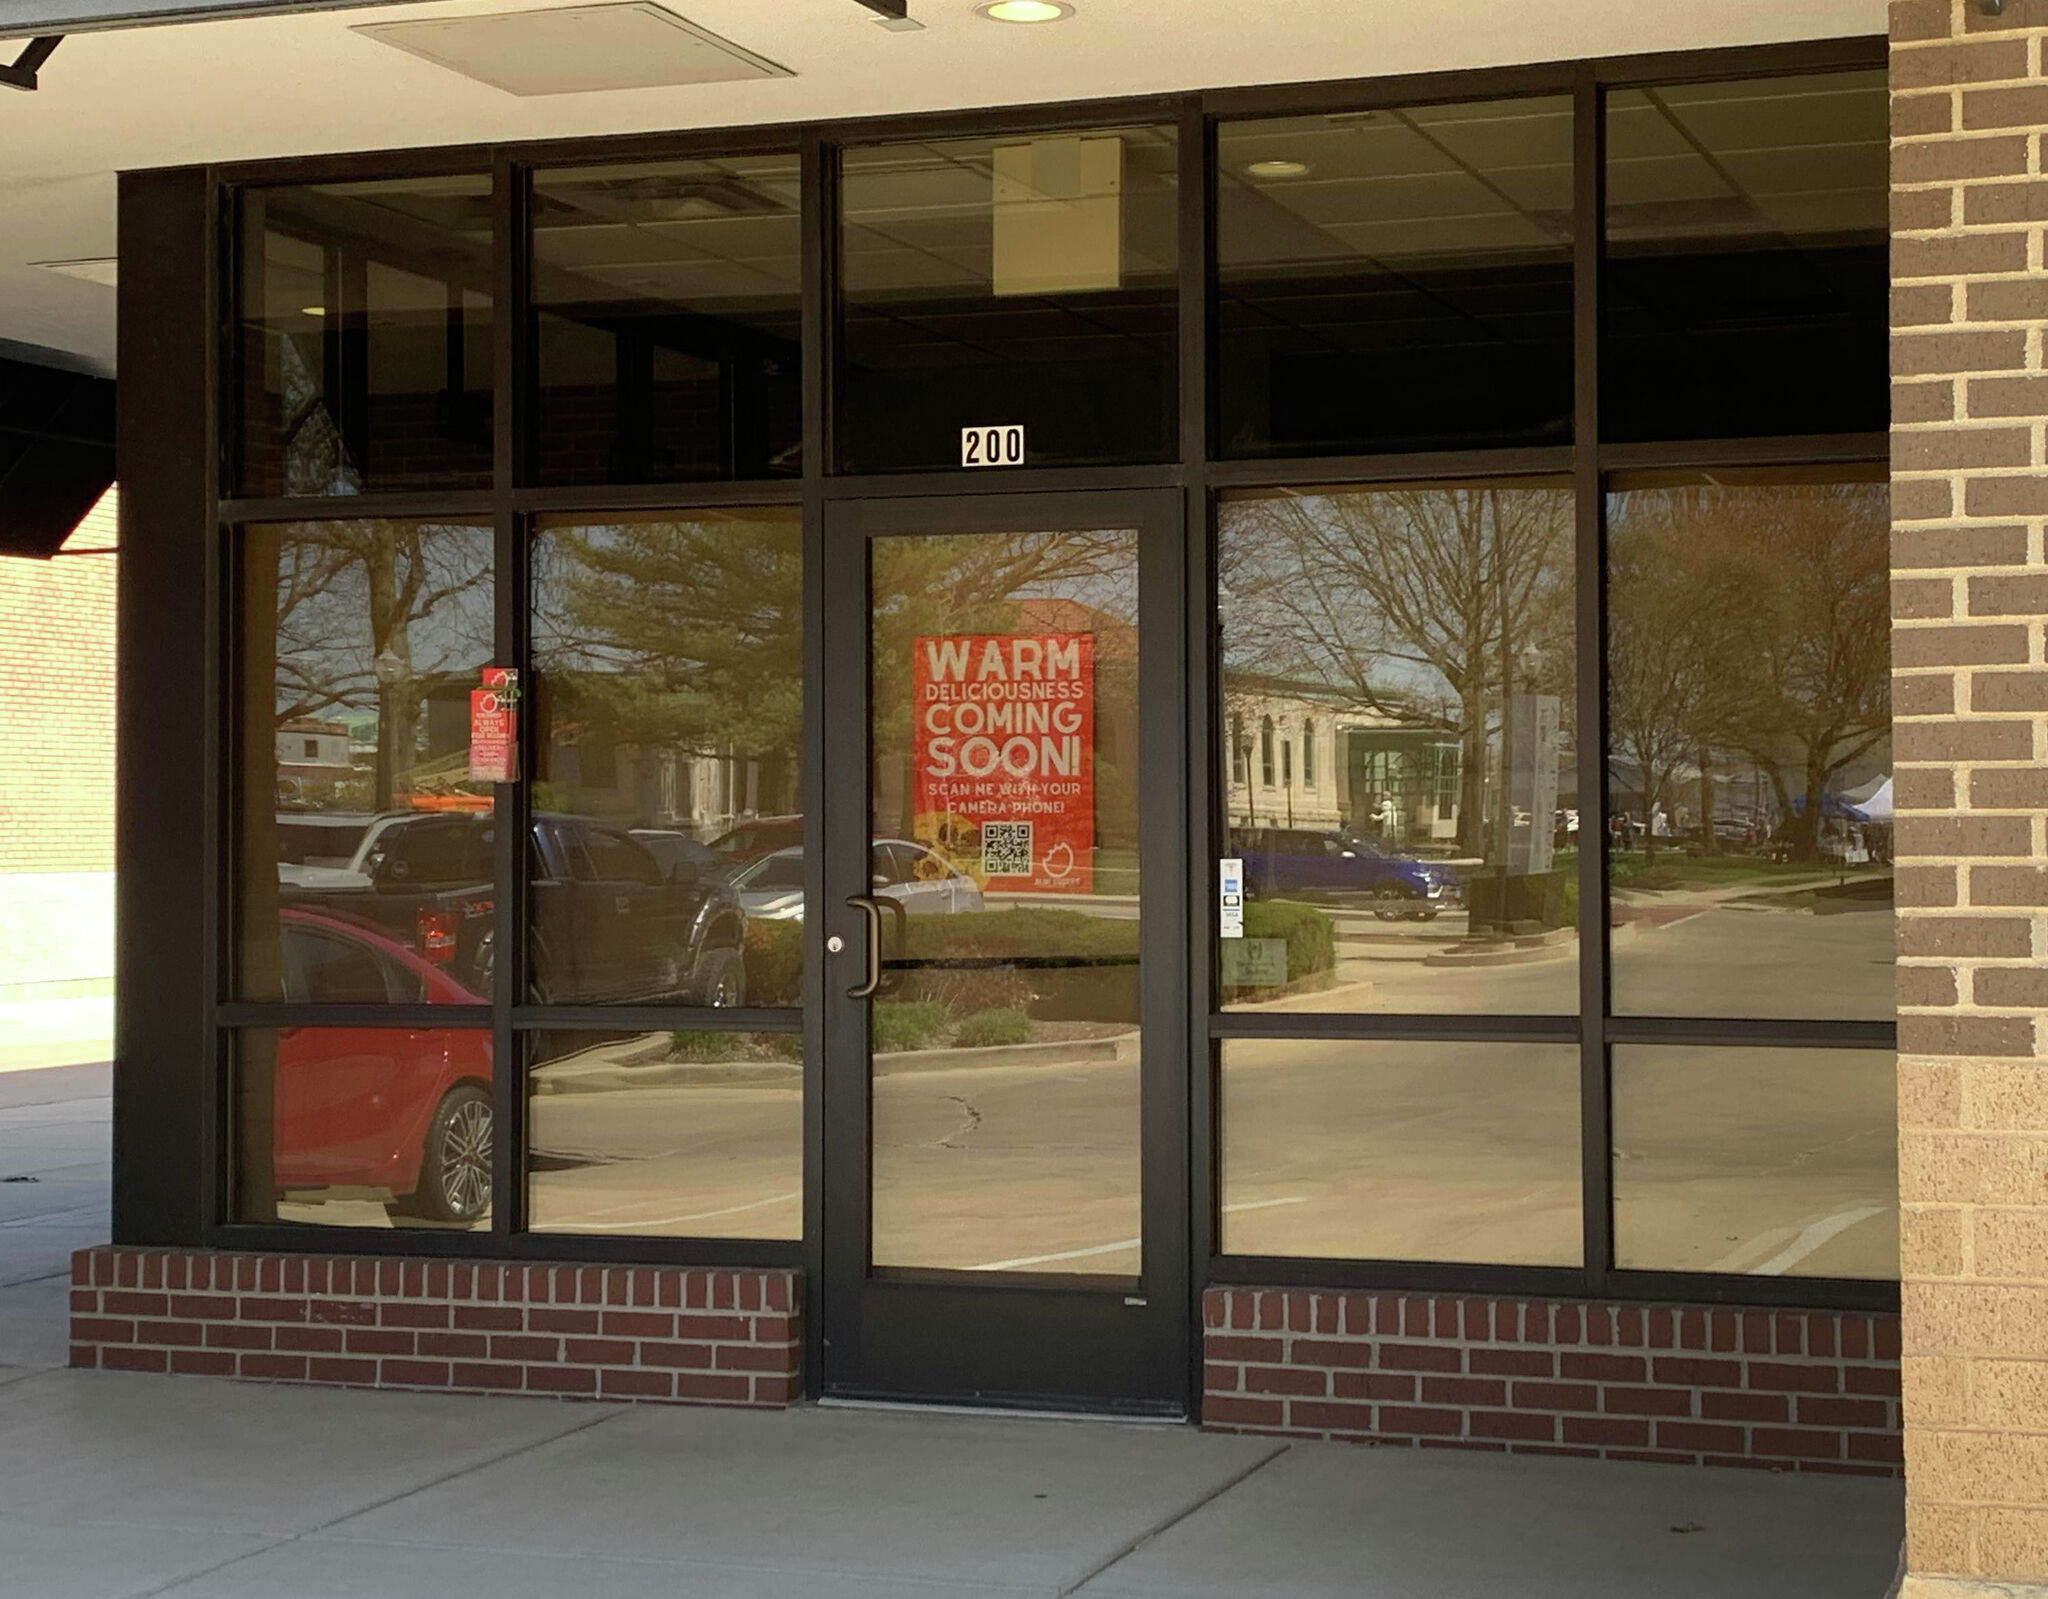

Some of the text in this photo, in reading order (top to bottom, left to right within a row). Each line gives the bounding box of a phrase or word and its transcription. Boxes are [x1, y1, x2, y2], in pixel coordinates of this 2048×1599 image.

[966, 428, 1020, 464] 200
[926, 638, 1081, 682] WARM
[925, 681, 1084, 701] DELICIOUSNESS
[925, 701, 1083, 735] COMING
[926, 735, 1081, 777] SOON!
[928, 782, 1081, 796] SCAN ME WITH YOUR
[948, 800, 1065, 815] CAMERA PHONE!
